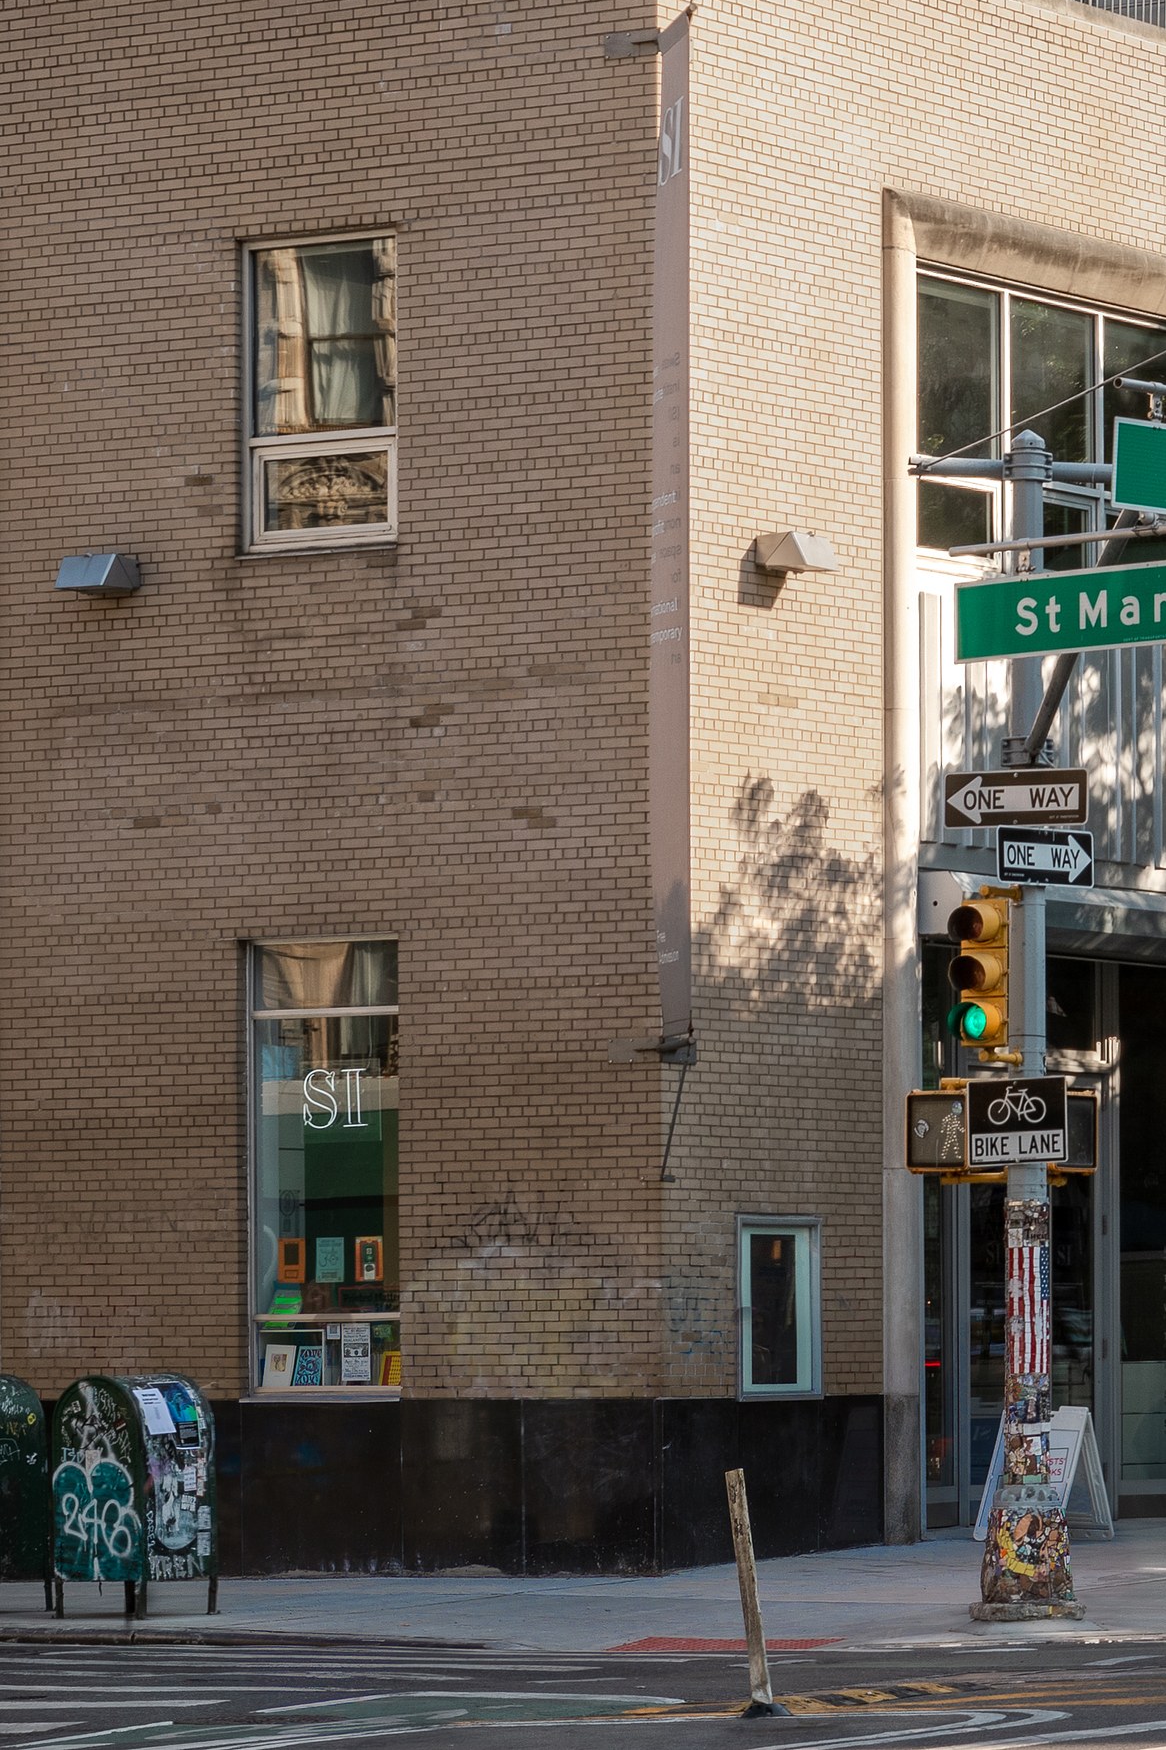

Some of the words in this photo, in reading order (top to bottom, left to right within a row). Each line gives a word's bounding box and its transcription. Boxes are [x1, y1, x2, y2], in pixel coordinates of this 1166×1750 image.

[1015, 596, 1061, 636] St
[963, 789, 1005, 811] ONE
[1029, 787, 1074, 809] WAY
[1007, 844, 1035, 867] ONE
[1051, 847, 1080, 869] WAY
[303, 1068, 369, 1129] SI
[974, 1136, 1010, 1157] BIKE
[1019, 1133, 1061, 1155] LANE
